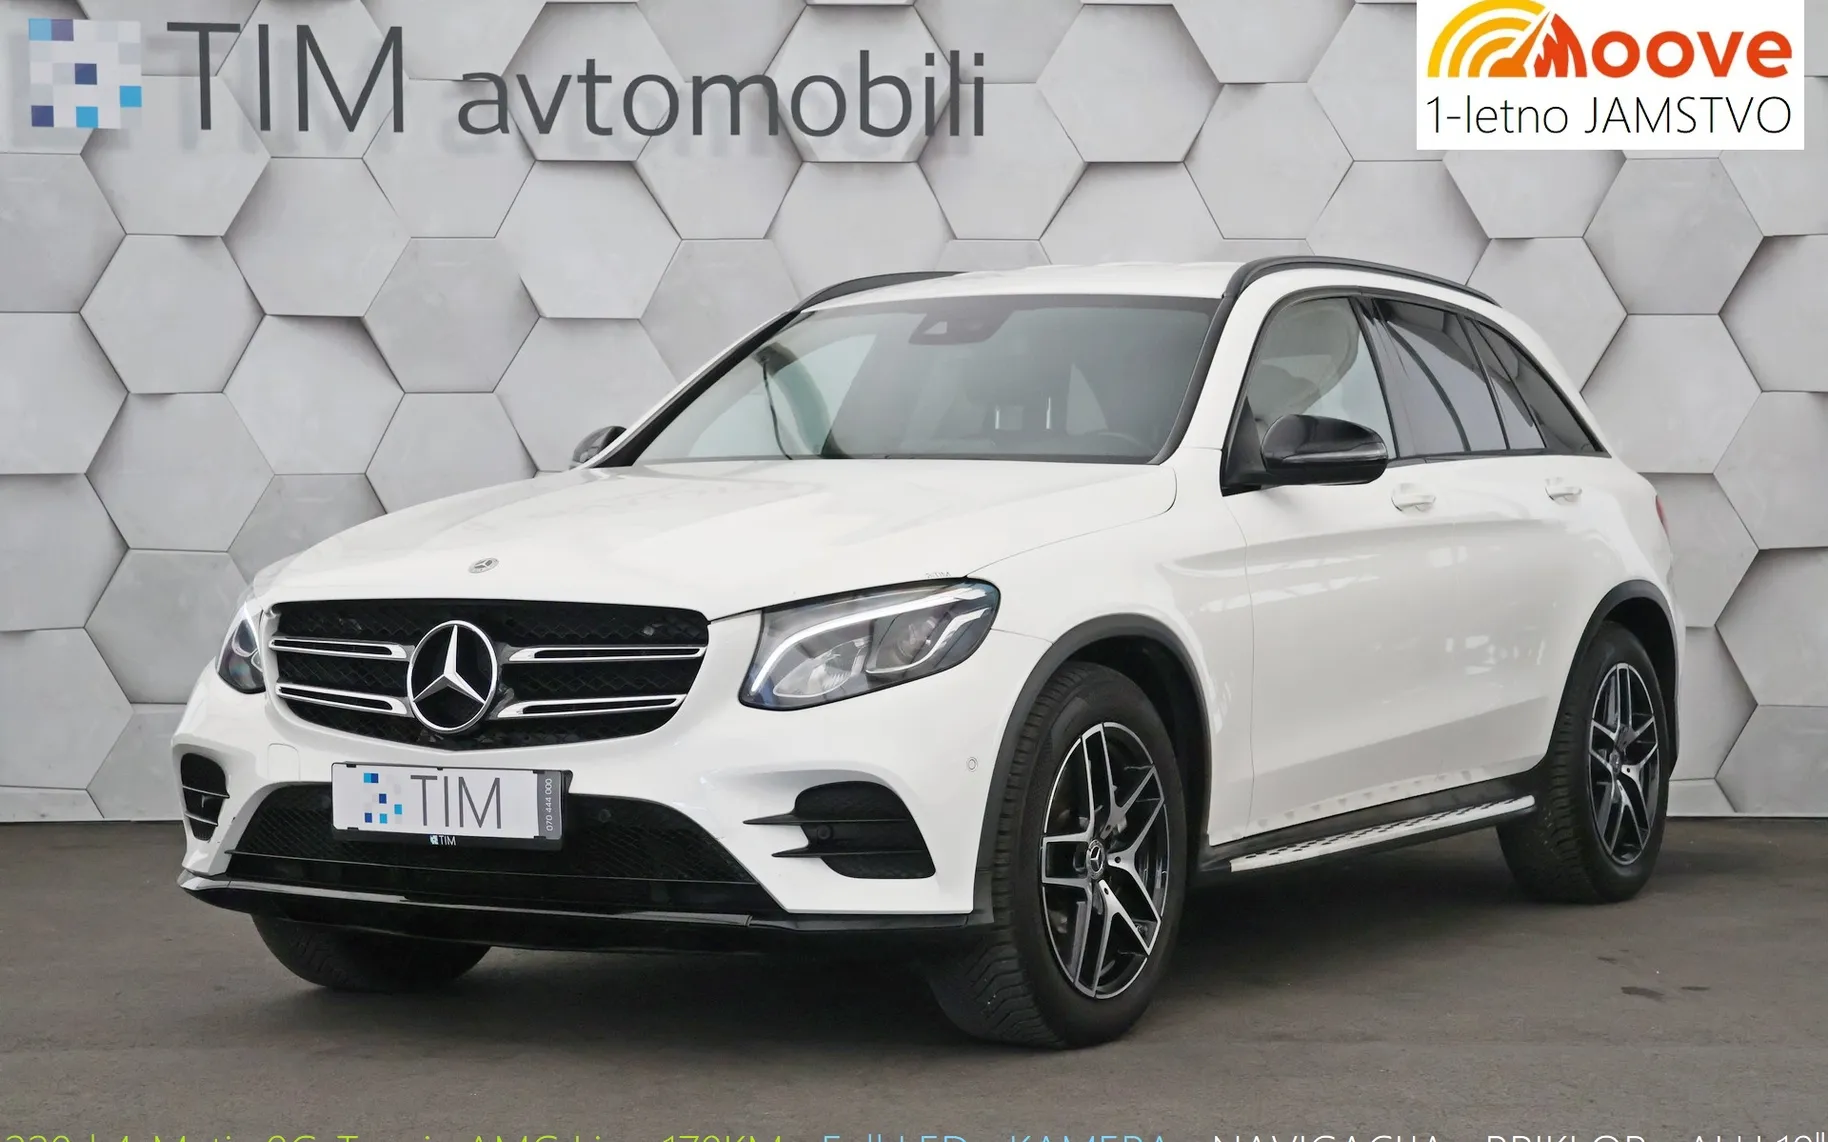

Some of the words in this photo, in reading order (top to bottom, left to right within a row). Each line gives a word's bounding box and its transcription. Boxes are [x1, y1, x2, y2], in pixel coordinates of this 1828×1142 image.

[166, 21, 404, 133] TIM
[457, 49, 986, 138] avtomobili
[544, 778, 553, 795] 000
[410, 774, 502, 829] TIM
[545, 814, 554, 832] 070
[438, 834, 457, 846] TIM
